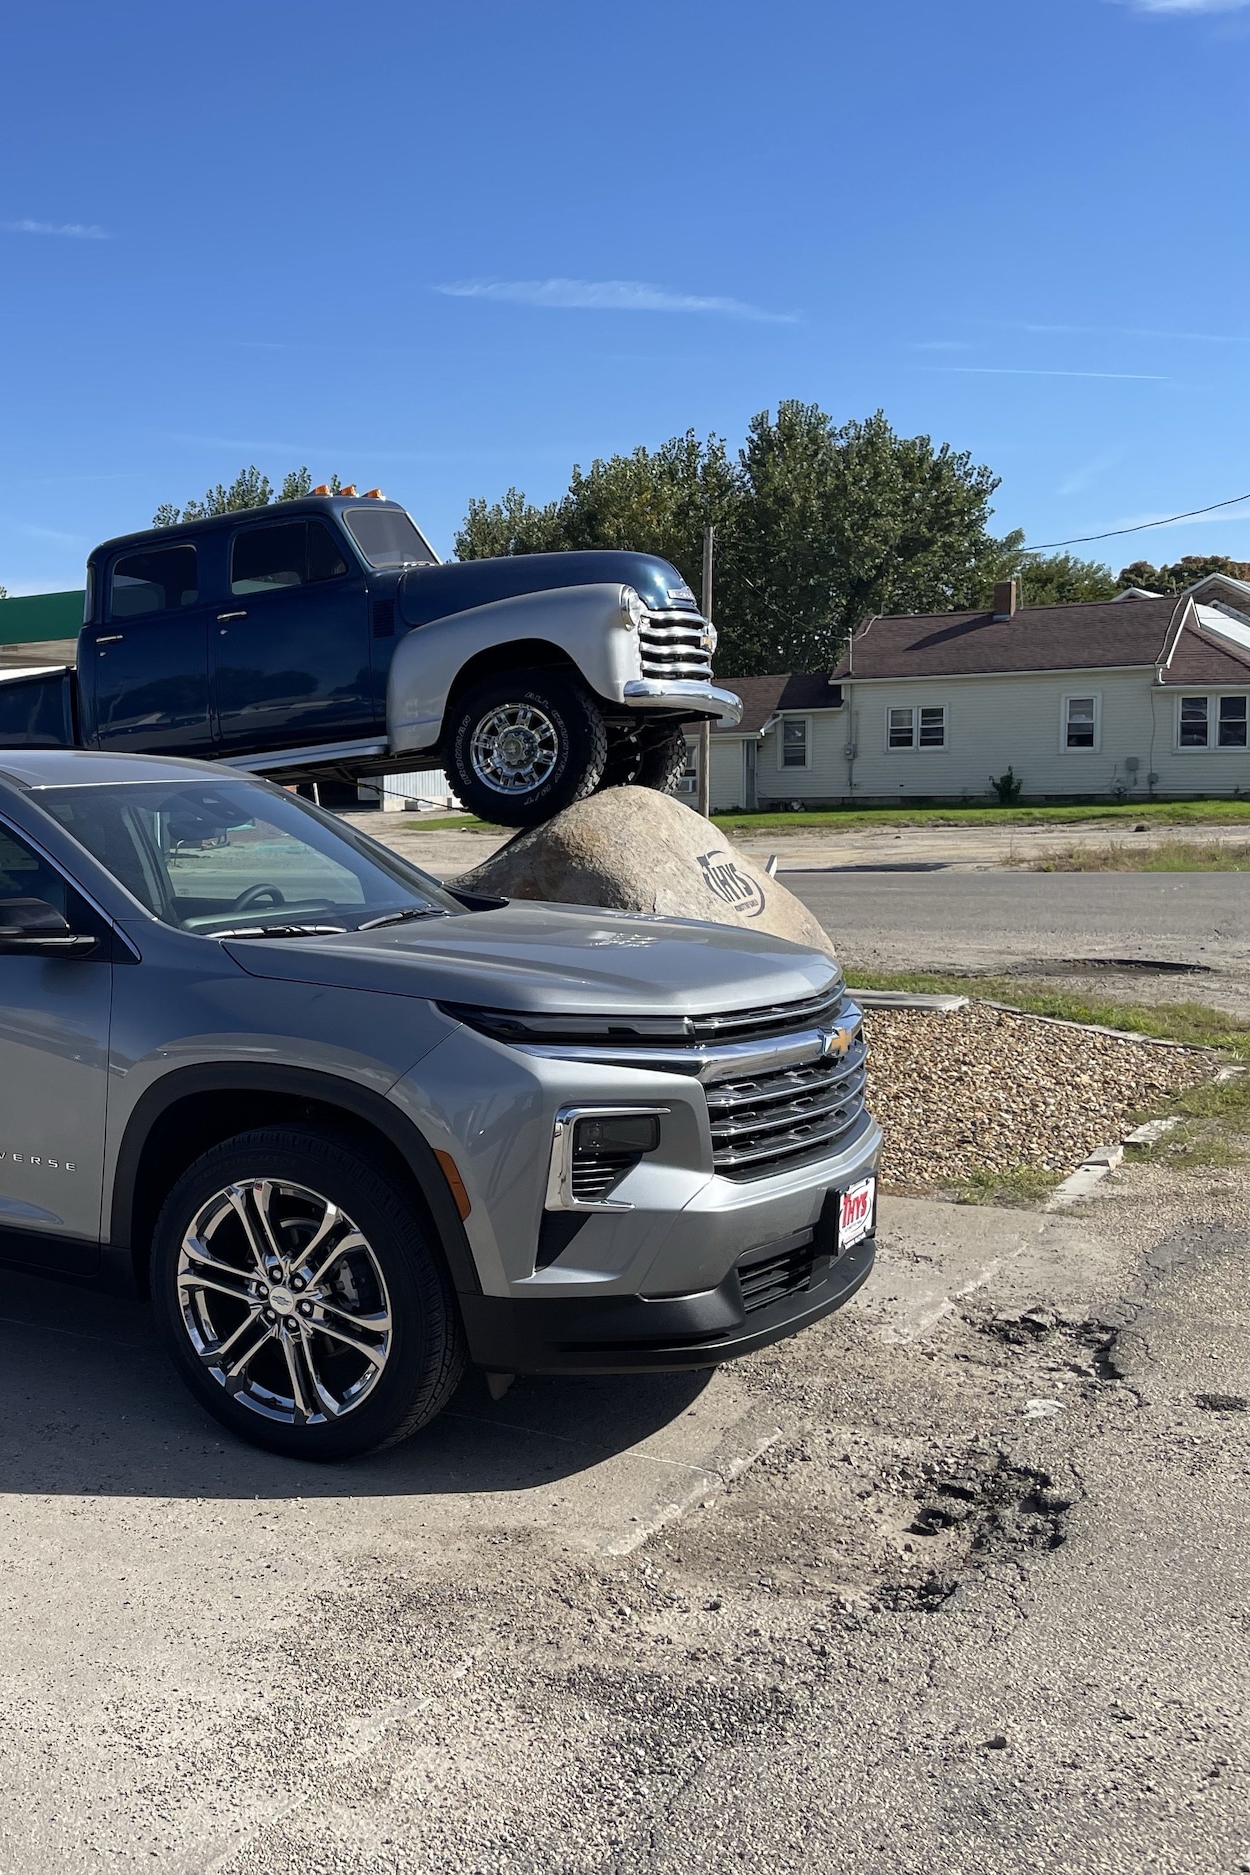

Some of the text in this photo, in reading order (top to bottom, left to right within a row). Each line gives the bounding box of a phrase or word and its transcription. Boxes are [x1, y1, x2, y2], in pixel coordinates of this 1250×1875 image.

[454, 714, 472, 786] IRONMAN
[524, 691, 550, 709] ALL
[550, 709, 570, 783] COUNTRY
[696, 853, 754, 902] THYS
[842, 1191, 868, 1228] THYS
